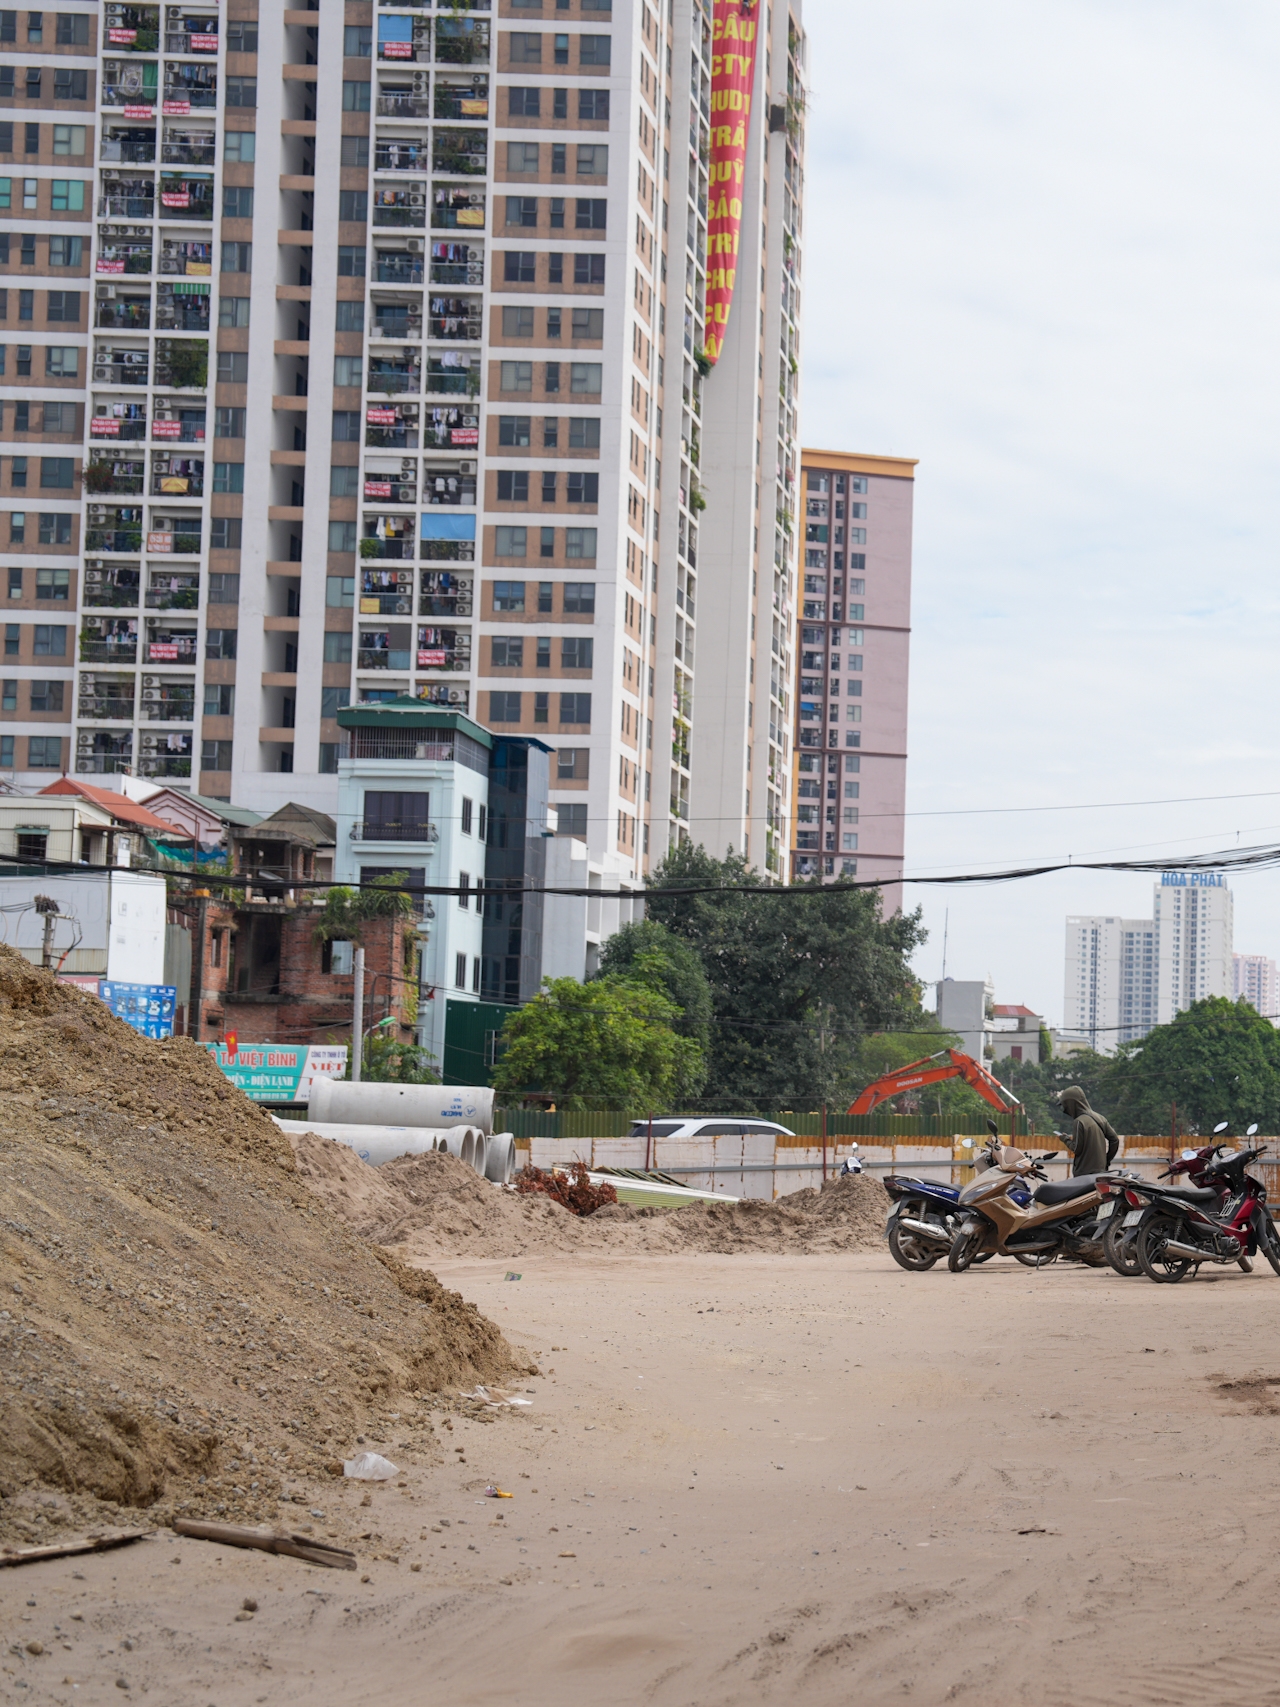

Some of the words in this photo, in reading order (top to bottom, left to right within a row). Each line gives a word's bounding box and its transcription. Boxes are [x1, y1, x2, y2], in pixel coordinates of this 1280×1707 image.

[712, 11, 755, 42] CẦU
[711, 53, 752, 77] CTY
[1190, 871, 1223, 887] PHÁT
[239, 1049, 264, 1069] VIỆT
[267, 1050, 297, 1067] BÌNH
[311, 1060, 344, 1074] VIỆT
[896, 1077, 923, 1088] DOOSAN
